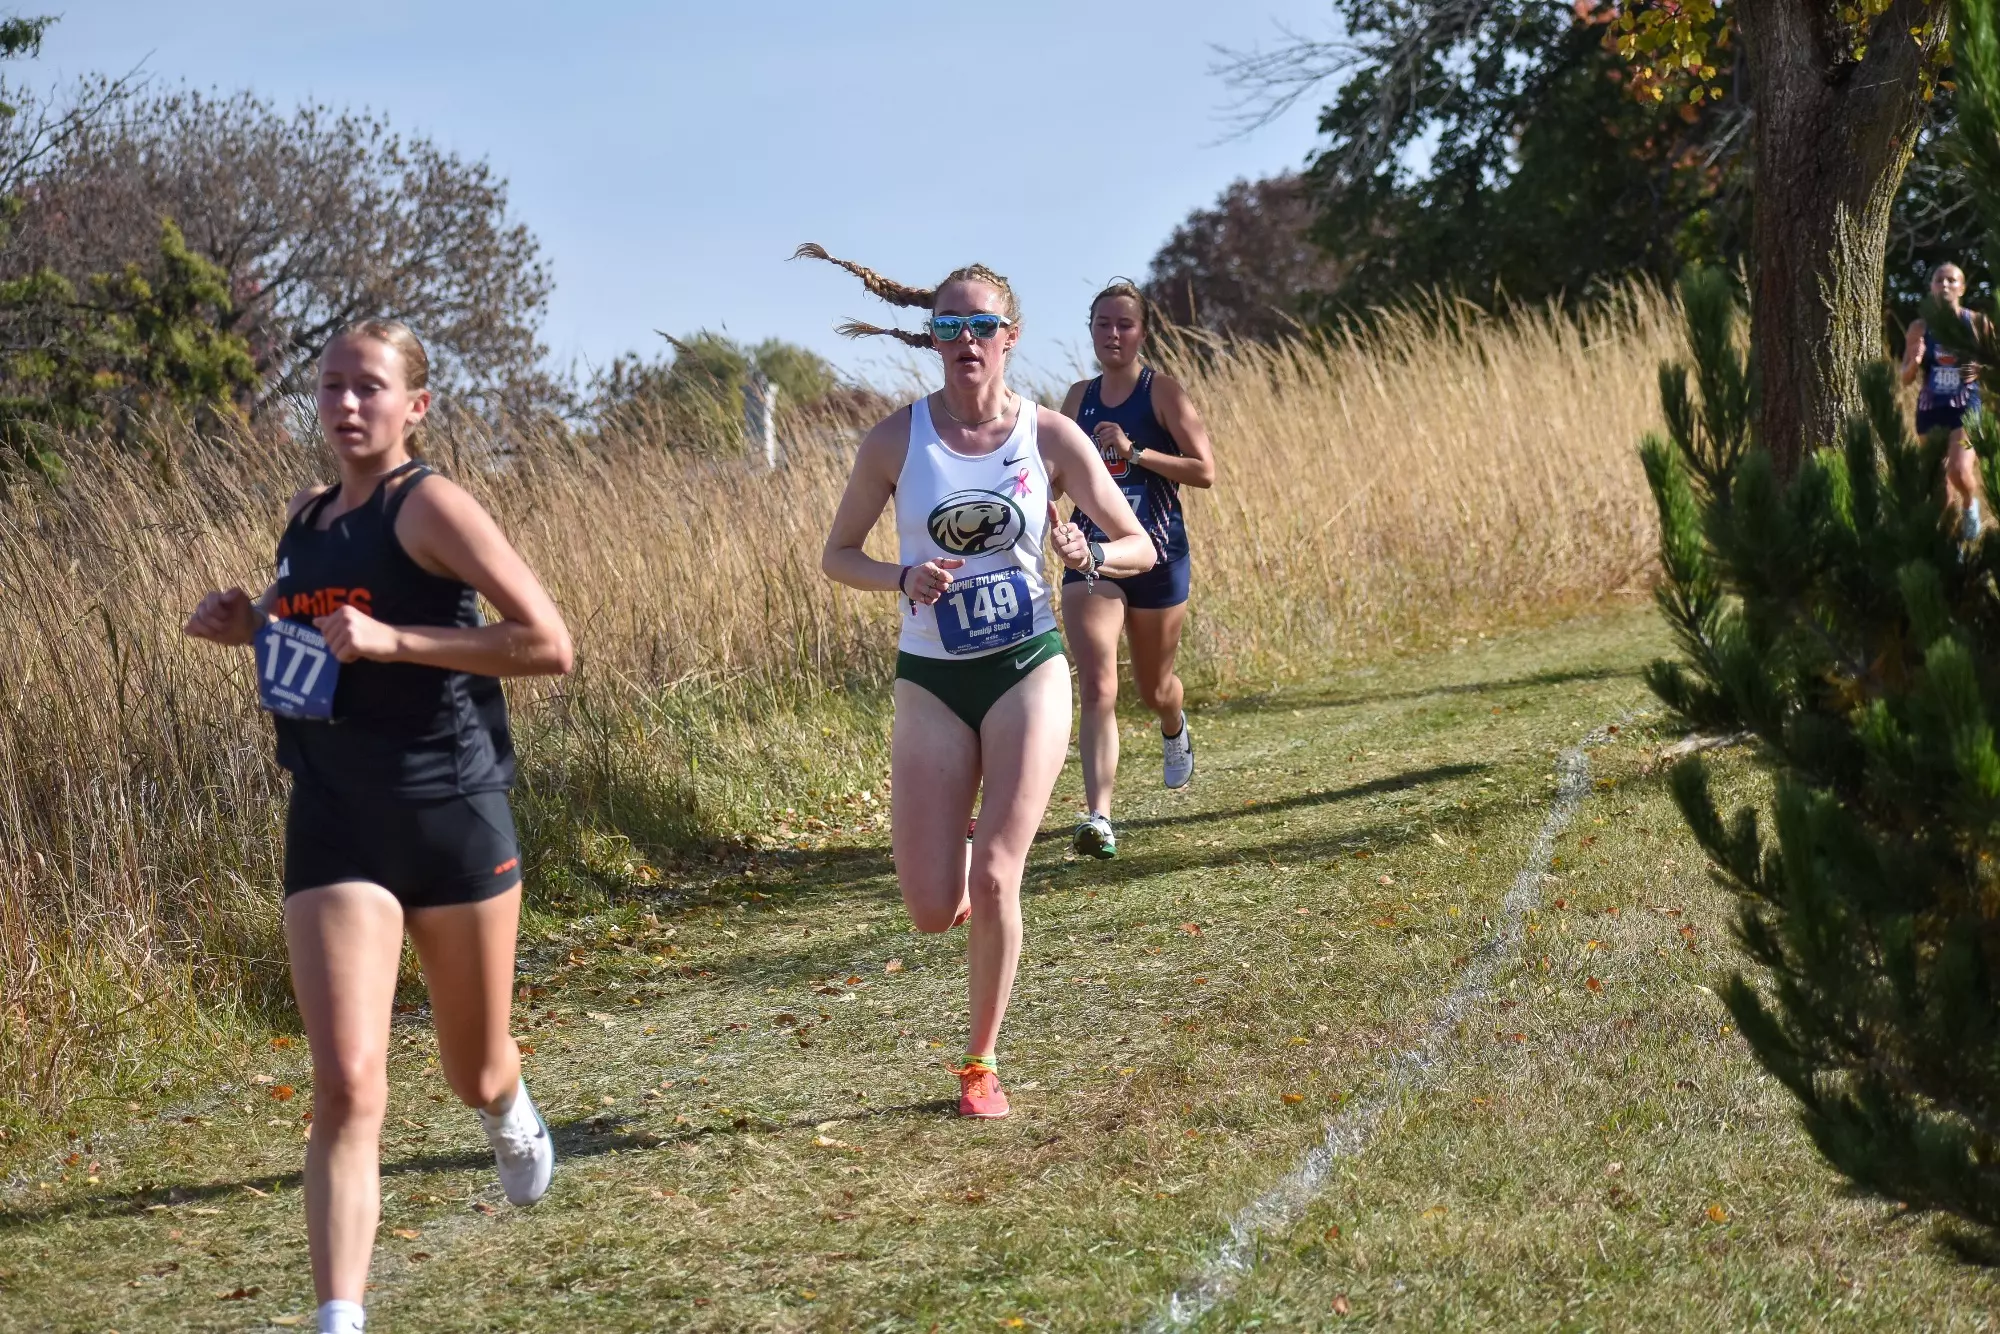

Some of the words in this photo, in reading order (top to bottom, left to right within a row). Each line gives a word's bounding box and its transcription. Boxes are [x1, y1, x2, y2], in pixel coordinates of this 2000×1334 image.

[946, 579, 975, 593] SOPHIE
[976, 570, 1011, 586] RYLANCE
[948, 582, 1019, 630] 149
[969, 625, 992, 637] Bemidji
[993, 622, 1011, 632] State
[265, 632, 327, 695] 177
